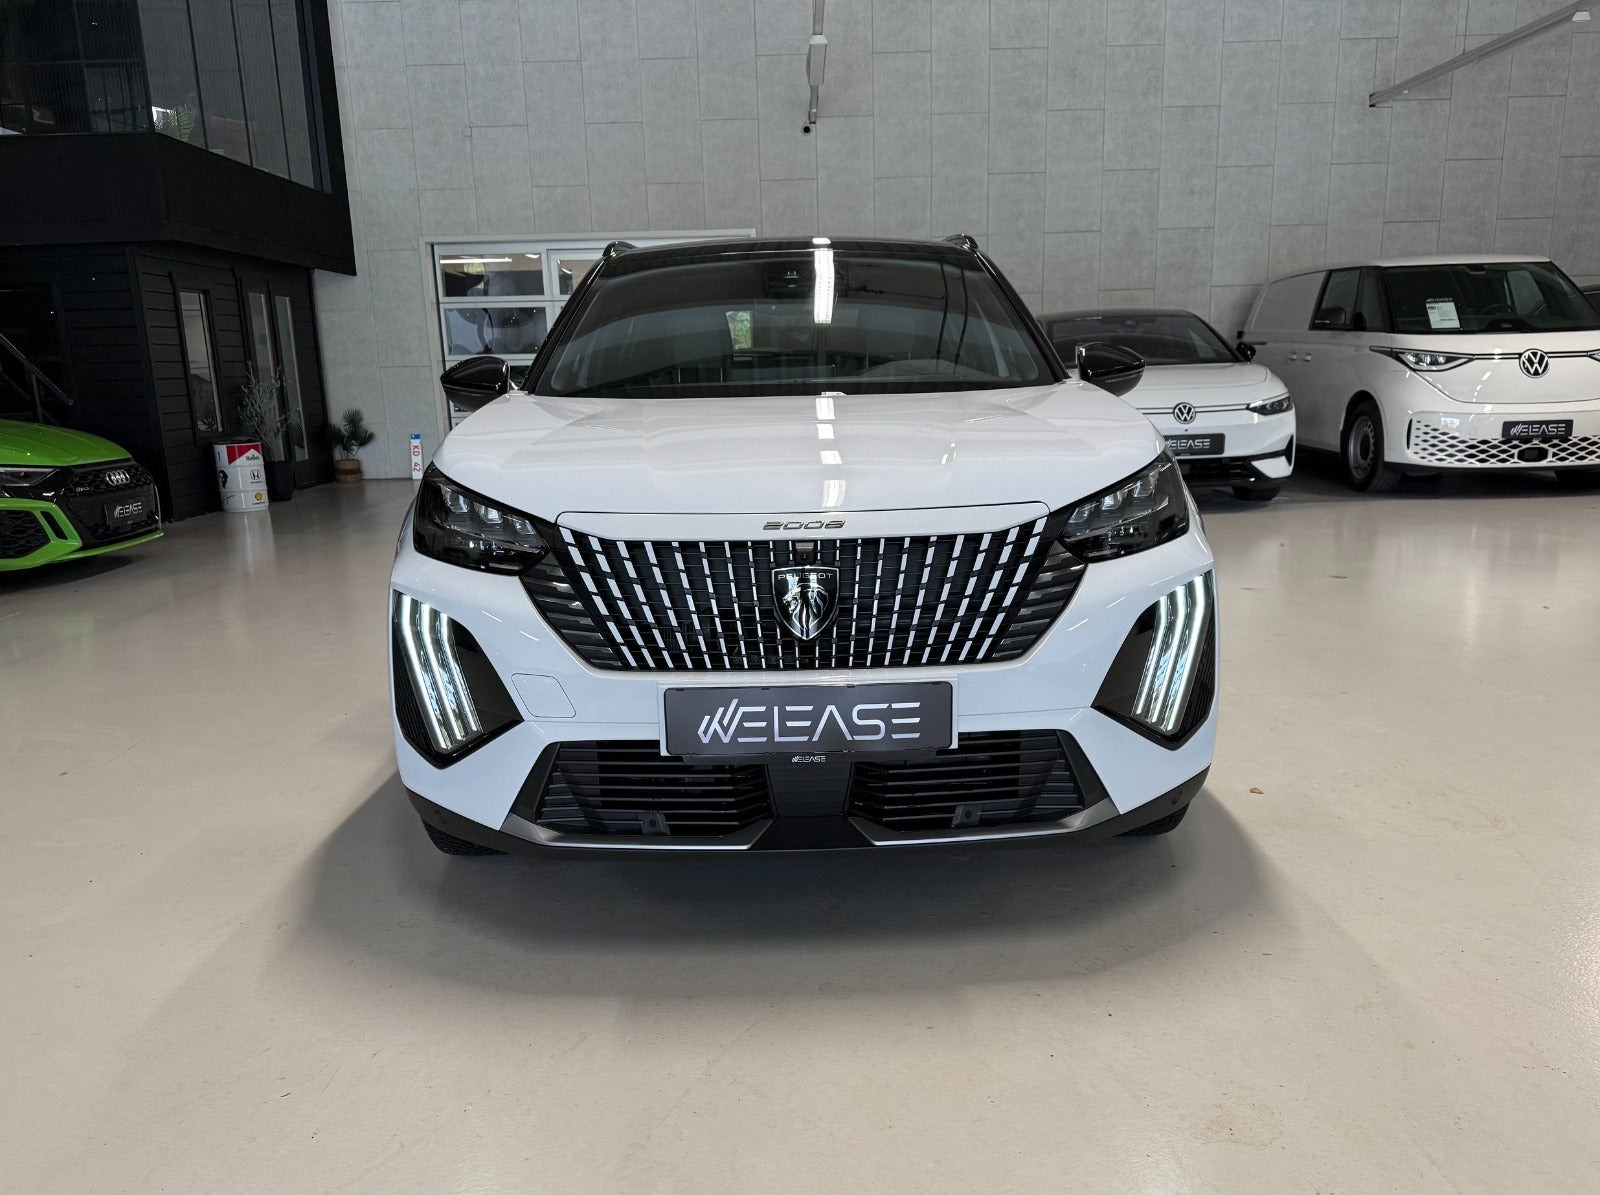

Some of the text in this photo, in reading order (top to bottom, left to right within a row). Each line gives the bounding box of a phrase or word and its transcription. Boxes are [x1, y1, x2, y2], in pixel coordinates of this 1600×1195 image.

[1511, 424, 1566, 436] WELEASE
[763, 520, 845, 530] 2008
[778, 572, 833, 580] PEUGEOT
[698, 698, 921, 744] WELEASE
